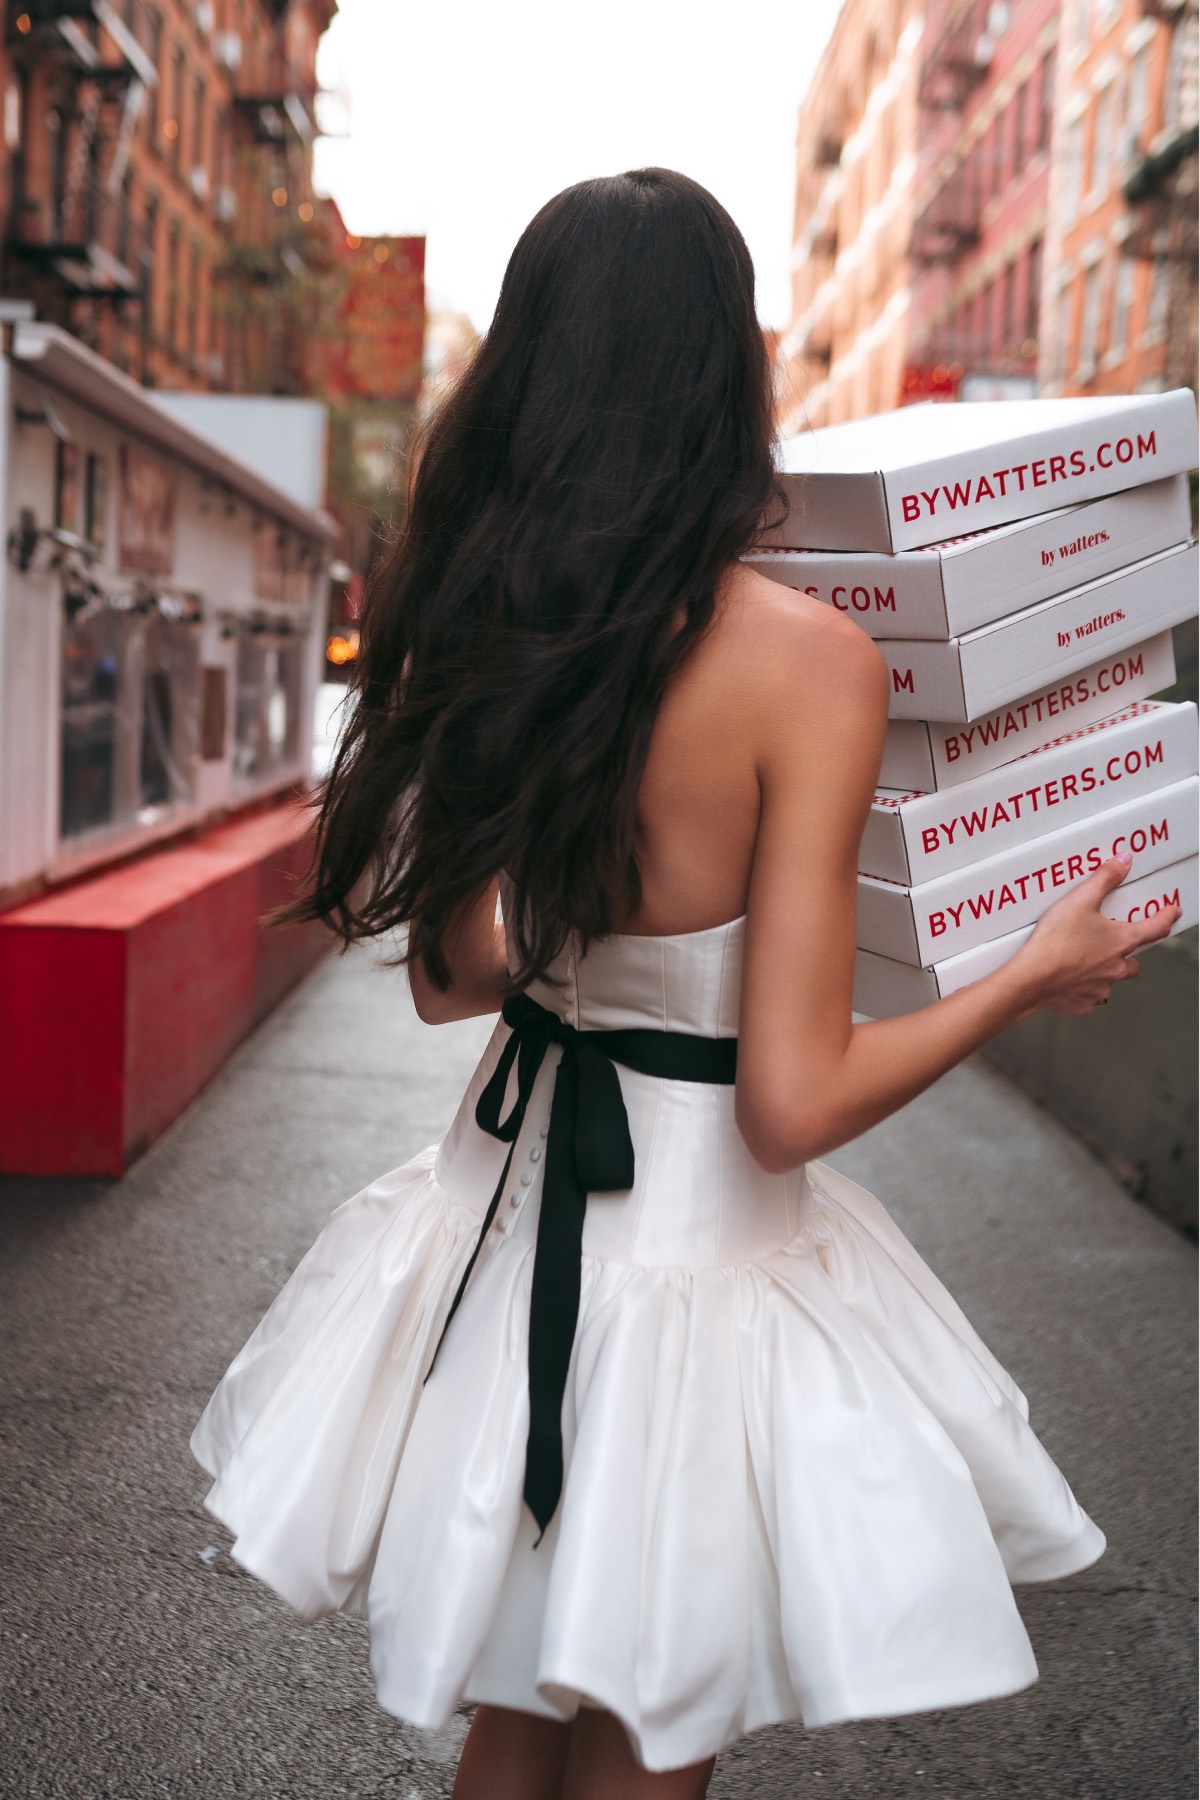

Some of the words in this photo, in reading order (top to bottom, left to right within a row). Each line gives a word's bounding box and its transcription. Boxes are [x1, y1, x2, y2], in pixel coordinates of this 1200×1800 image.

[901, 431, 1157, 523] BYWATTERS.COM
[1041, 550, 1056, 567] by
[1059, 529, 1110, 559] watters.
[1057, 631, 1072, 648] by
[1075, 608, 1126, 639] watters.
[944, 653, 1145, 763] BYWATTERS.COM
[921, 740, 1164, 855] BYWATTERS.COM
[928, 818, 1169, 938] BYWATTERSCOM
